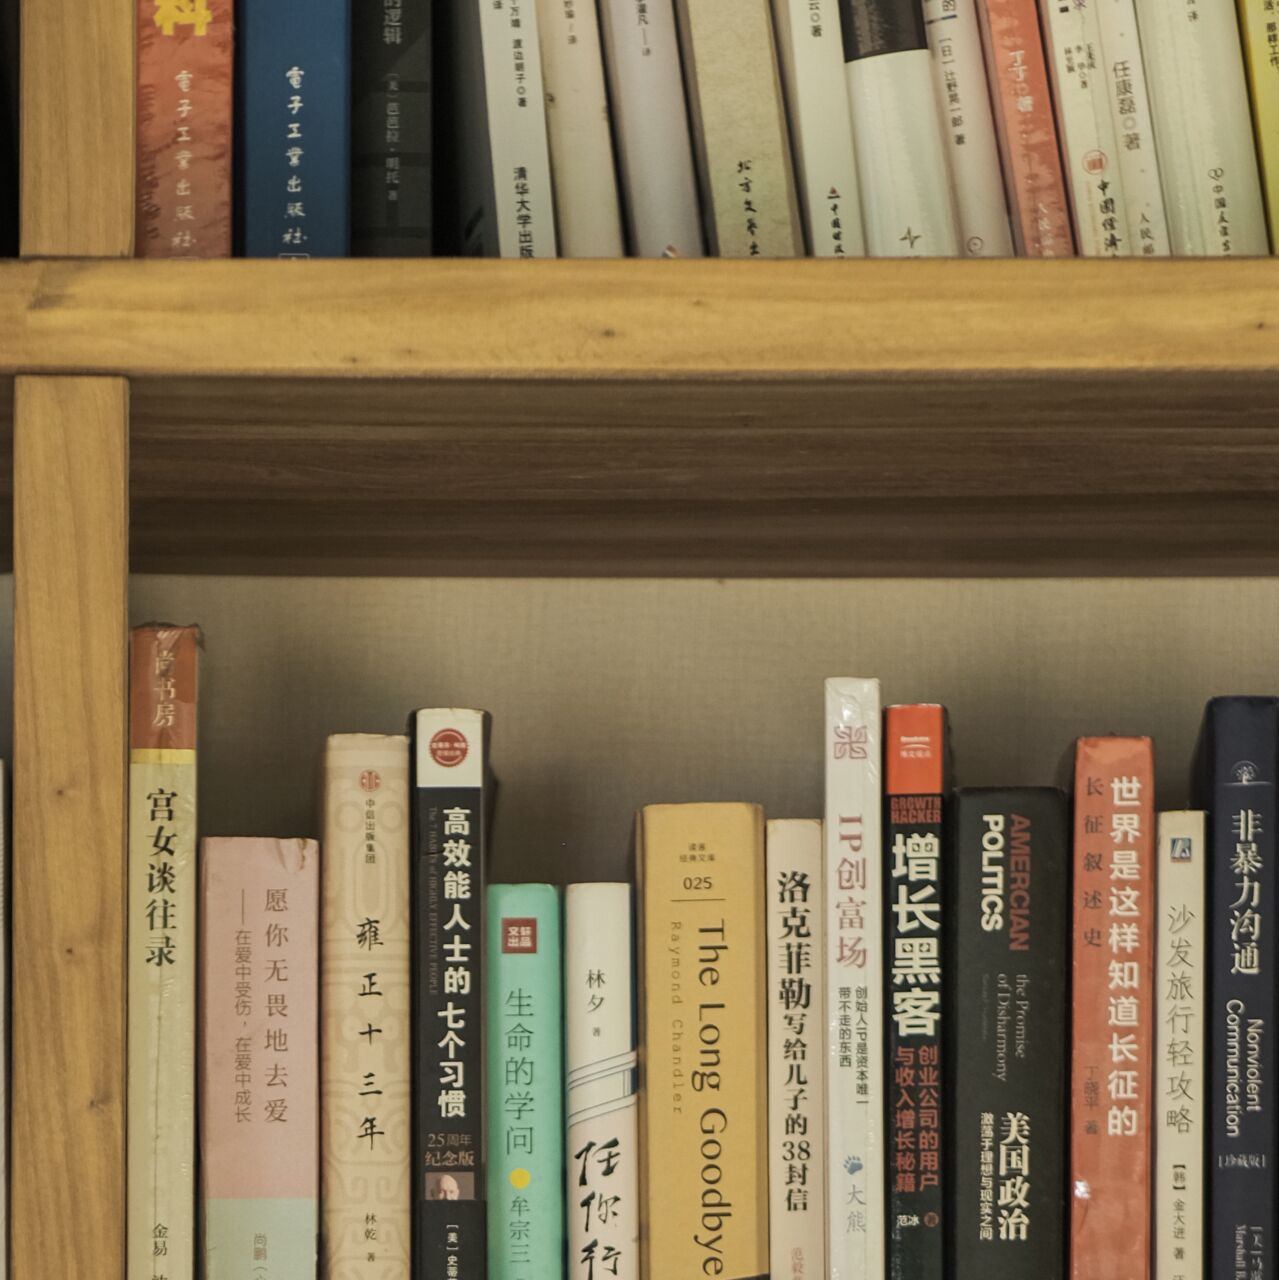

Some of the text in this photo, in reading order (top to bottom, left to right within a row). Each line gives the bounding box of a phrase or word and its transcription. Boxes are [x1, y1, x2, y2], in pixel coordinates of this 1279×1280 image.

[144, 788, 178, 968] 宫女谈往录
[682, 876, 713, 890] 025
[890, 810, 941, 824] HACKER
[981, 814, 1004, 932] POLITICS
[1009, 814, 1031, 951] AMERCIAN
[1083, 776, 1104, 948] 长征叙述史
[437, 807, 472, 1120] 高效能人士的七个习惯
[835, 815, 868, 969] IP创富场
[891, 833, 942, 1037] 增长黑客
[1107, 776, 1142, 1137] 世界是这样知道长征的
[1229, 809, 1264, 975] 非暴力沟通
[263, 888, 289, 1124] 愿你无畏地去爱
[355, 916, 385, 1152] 雍正十三年
[586, 969, 606, 1014] 林夕
[671, 921, 682, 1115] Raymond Chandler
[777, 871, 812, 1212] 洛克菲勒写给儿子的38封信
[1165, 903, 1196, 1136] 沙发旅行轻攻略
[504, 989, 535, 1157] 生命的学问
[692, 919, 732, 1276] The Long Goodbye
[895, 1046, 915, 1192] 与收入增长秘籍
[918, 1045, 939, 1191] 创业公司的用户
[1225, 998, 1246, 1137] Communication
[1246, 1018, 1264, 1112] Nonviolent
[425, 1151, 475, 1167] 纪念版
[427, 1133, 472, 1147] 25周年
[979, 1112, 993, 1240] 激荡于理想与现实之间
[998, 1111, 1031, 1241] 美国政治
[364, 1213, 377, 1241] 林乾
[509, 1195, 531, 1265] 牟宗三
